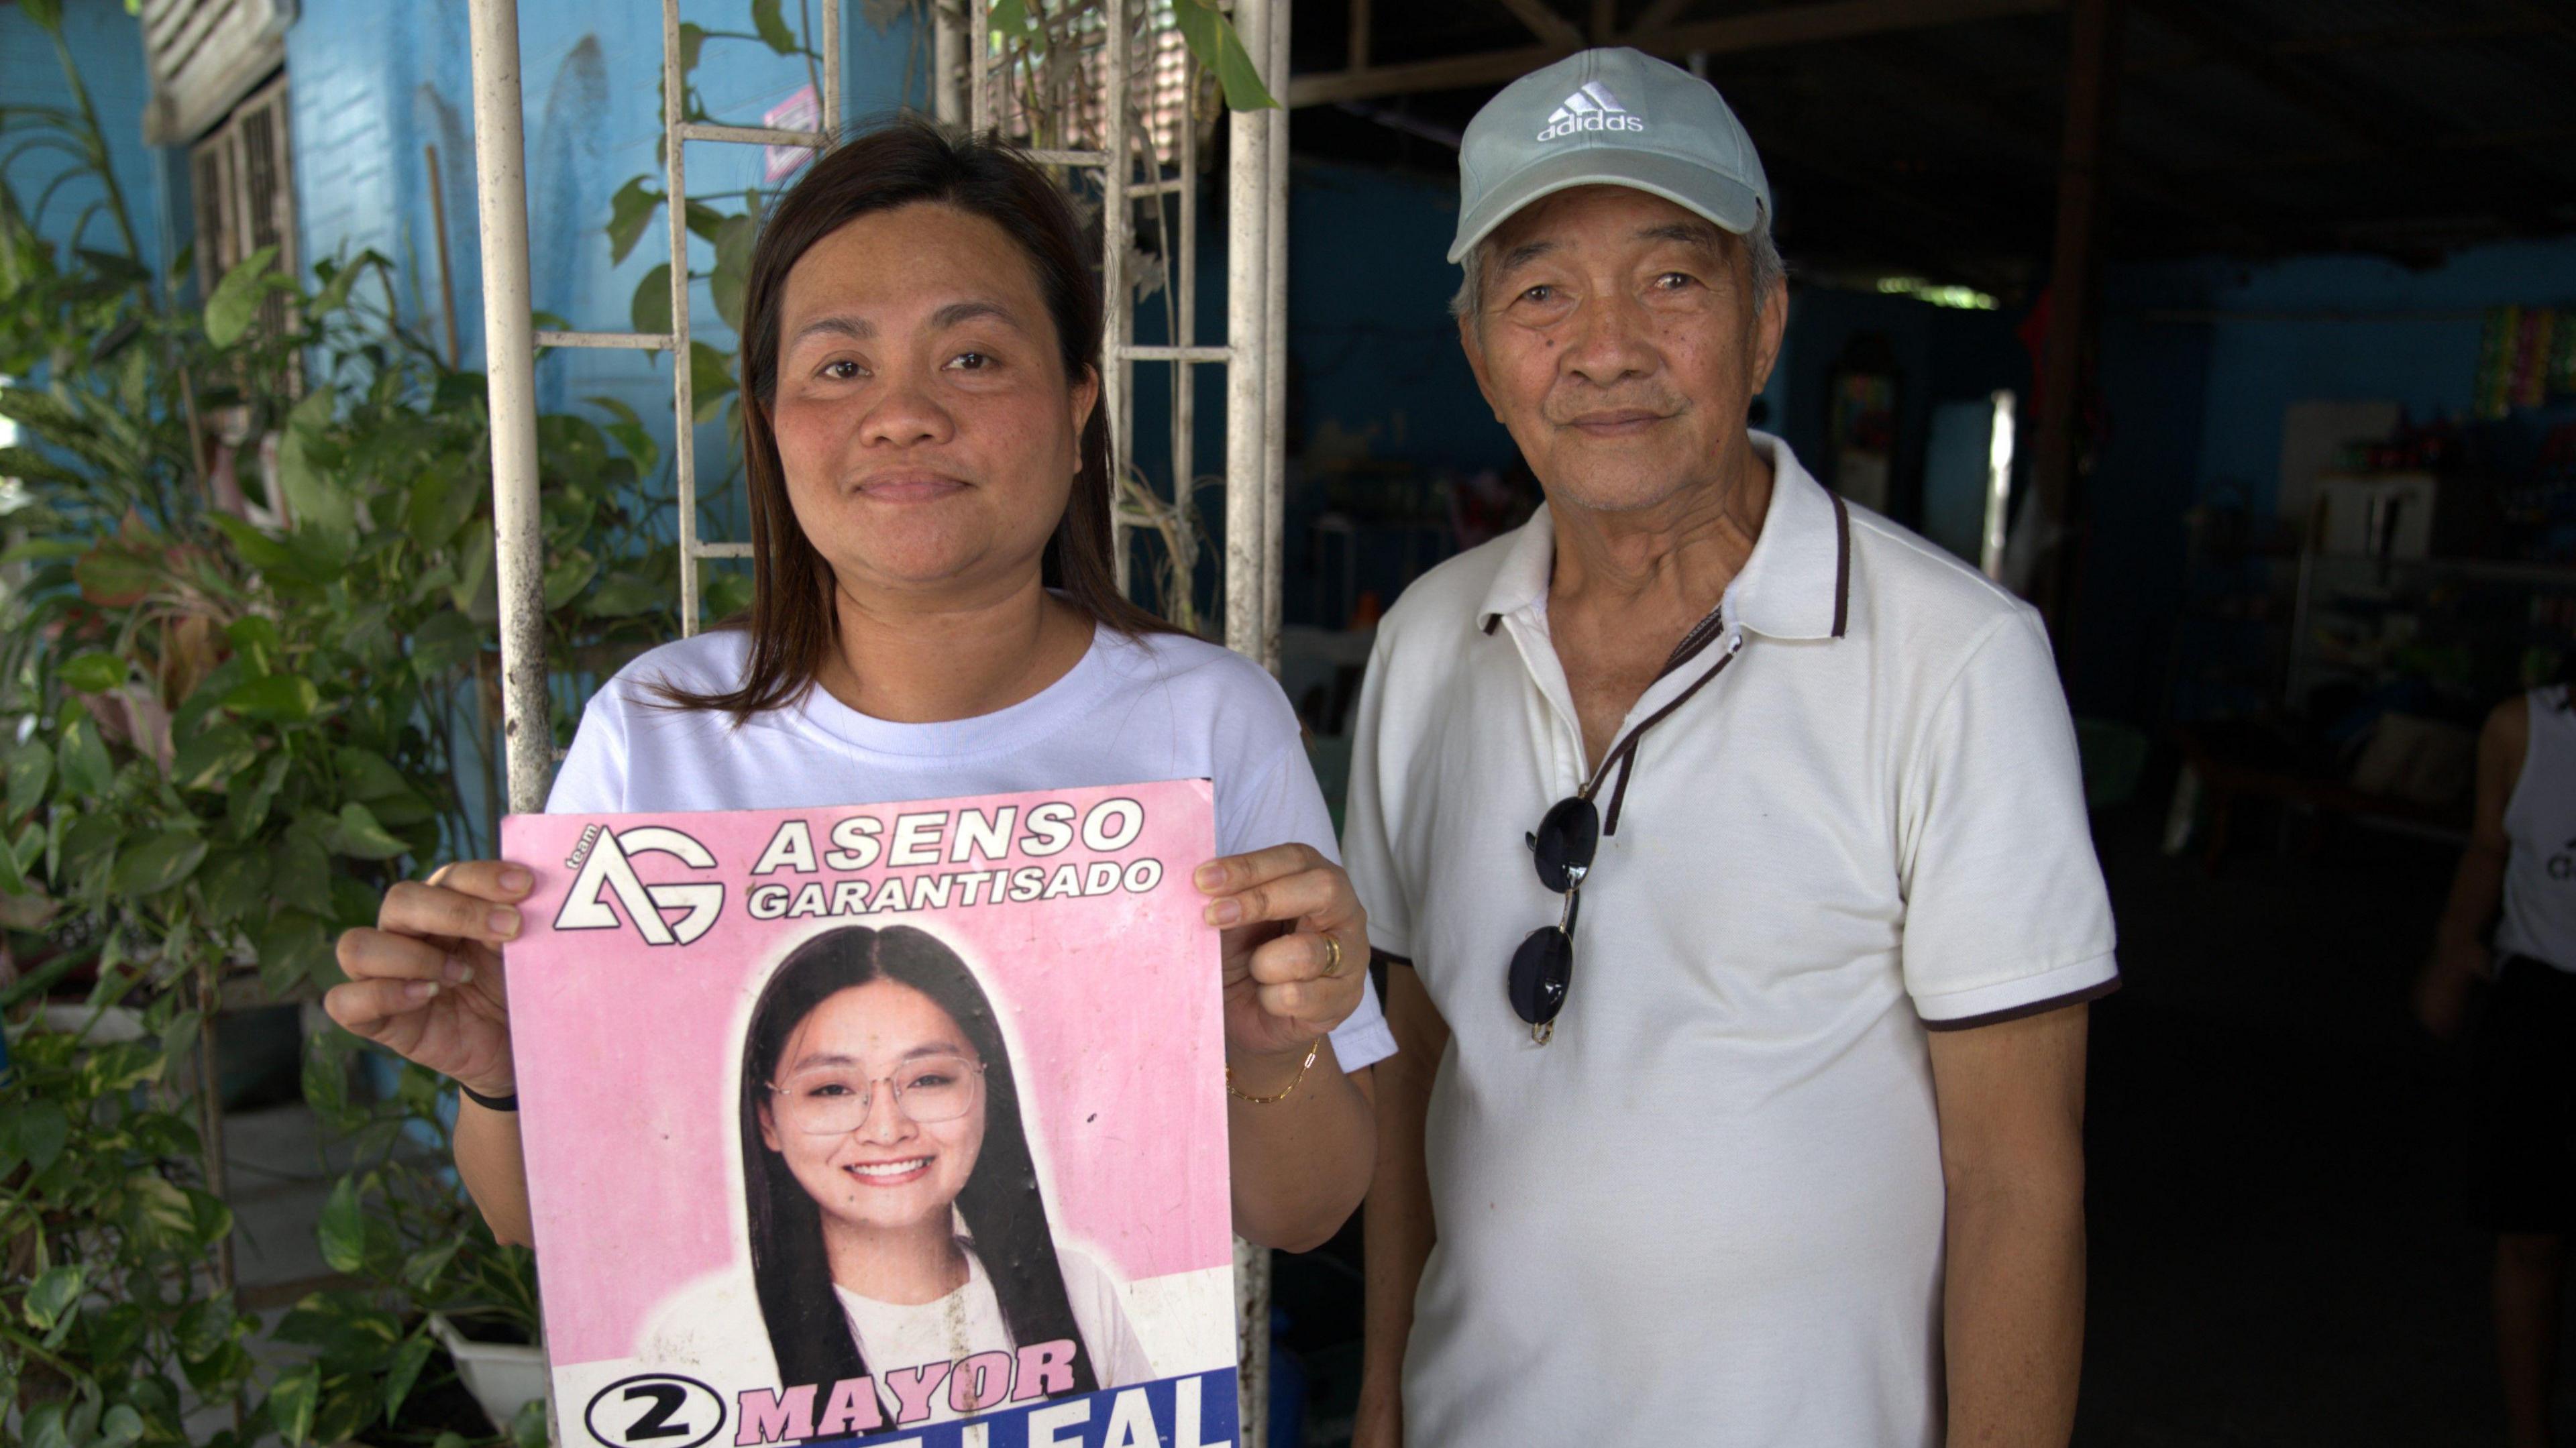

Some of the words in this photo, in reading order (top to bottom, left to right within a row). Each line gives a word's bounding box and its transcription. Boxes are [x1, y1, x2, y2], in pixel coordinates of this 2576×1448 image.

[1536, 109, 1644, 142] adidas
[565, 823, 598, 871] team
[749, 797, 1144, 875] ASENSO
[553, 824, 725, 946] AG
[747, 858, 1163, 920] GARANTISADO
[623, 1382, 690, 1442] 2
[734, 1339, 1076, 1447] MAYOR
[962, 1375, 1232, 1448] AL
